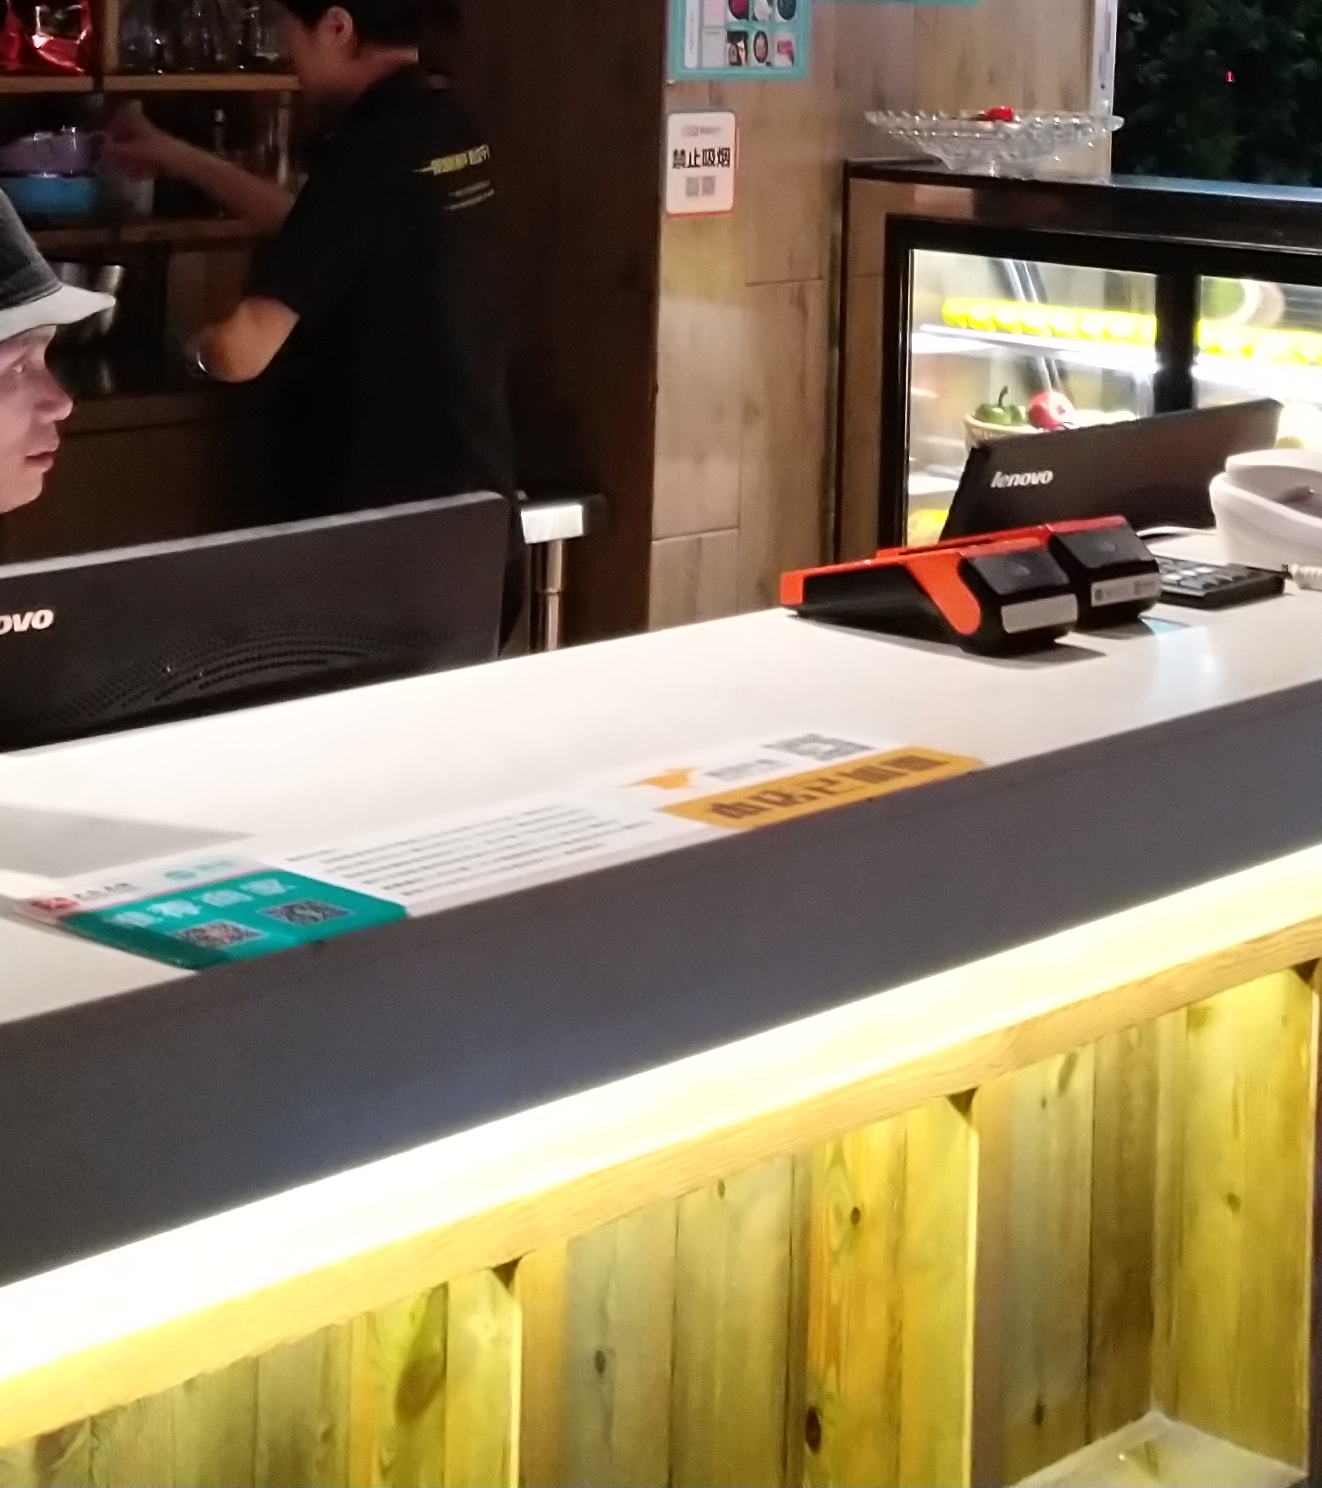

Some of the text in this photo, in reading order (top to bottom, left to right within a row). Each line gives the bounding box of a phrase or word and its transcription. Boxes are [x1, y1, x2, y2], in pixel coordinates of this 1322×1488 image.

[672, 146, 731, 170] 禁止吸烟
[990, 469, 1055, 489] lenovo
